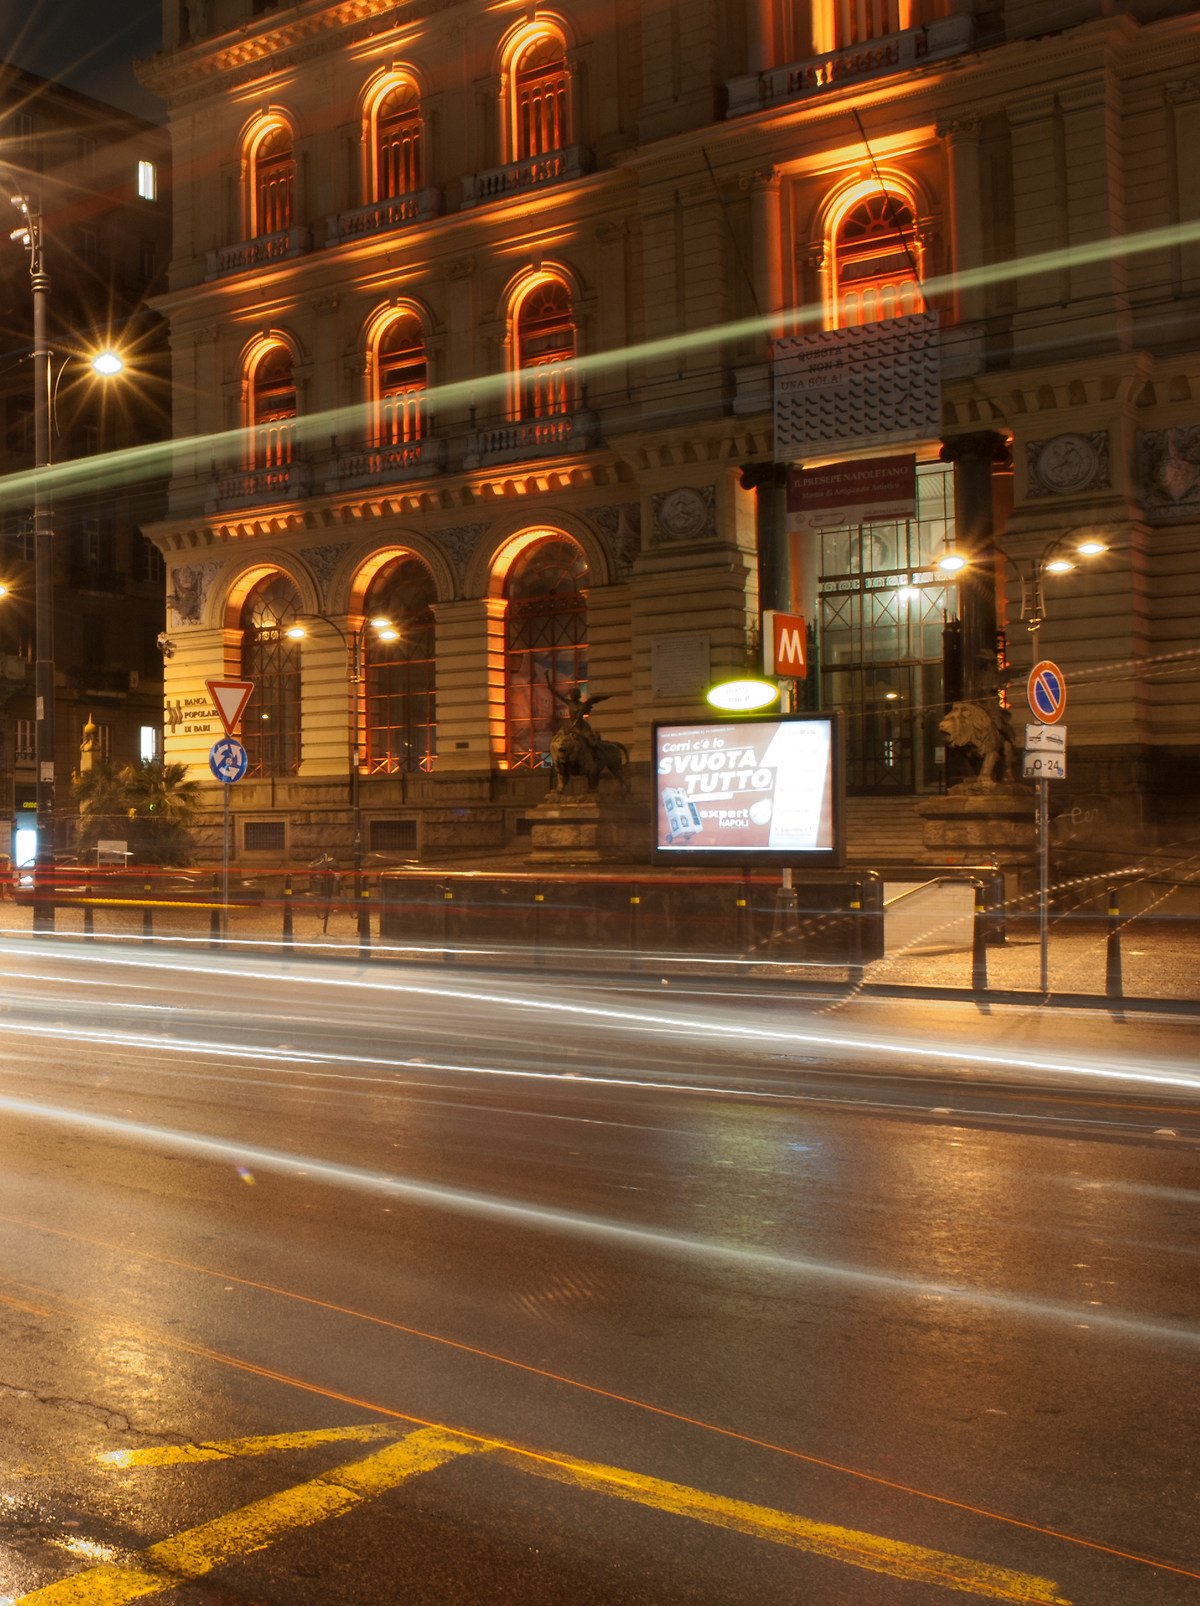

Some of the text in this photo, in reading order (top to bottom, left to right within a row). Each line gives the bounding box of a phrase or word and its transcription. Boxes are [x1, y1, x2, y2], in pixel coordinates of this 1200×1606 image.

[798, 347, 842, 362] QUESTA
[808, 361, 833, 373] NON
[781, 381, 804, 391] UNA
[803, 474, 842, 487] PRESEPE
[843, 466, 909, 481] NAPOLETANO
[778, 628, 804, 665] M
[184, 697, 207, 706] BANCA
[184, 724, 210, 733] DI BARI
[662, 740, 690, 753] Corri
[712, 737, 725, 748] lo
[658, 750, 757, 775] SVUOTA
[684, 768, 772, 794] TUTTO
[699, 809, 749, 820] expert
[719, 819, 749, 828] NAPOLI
